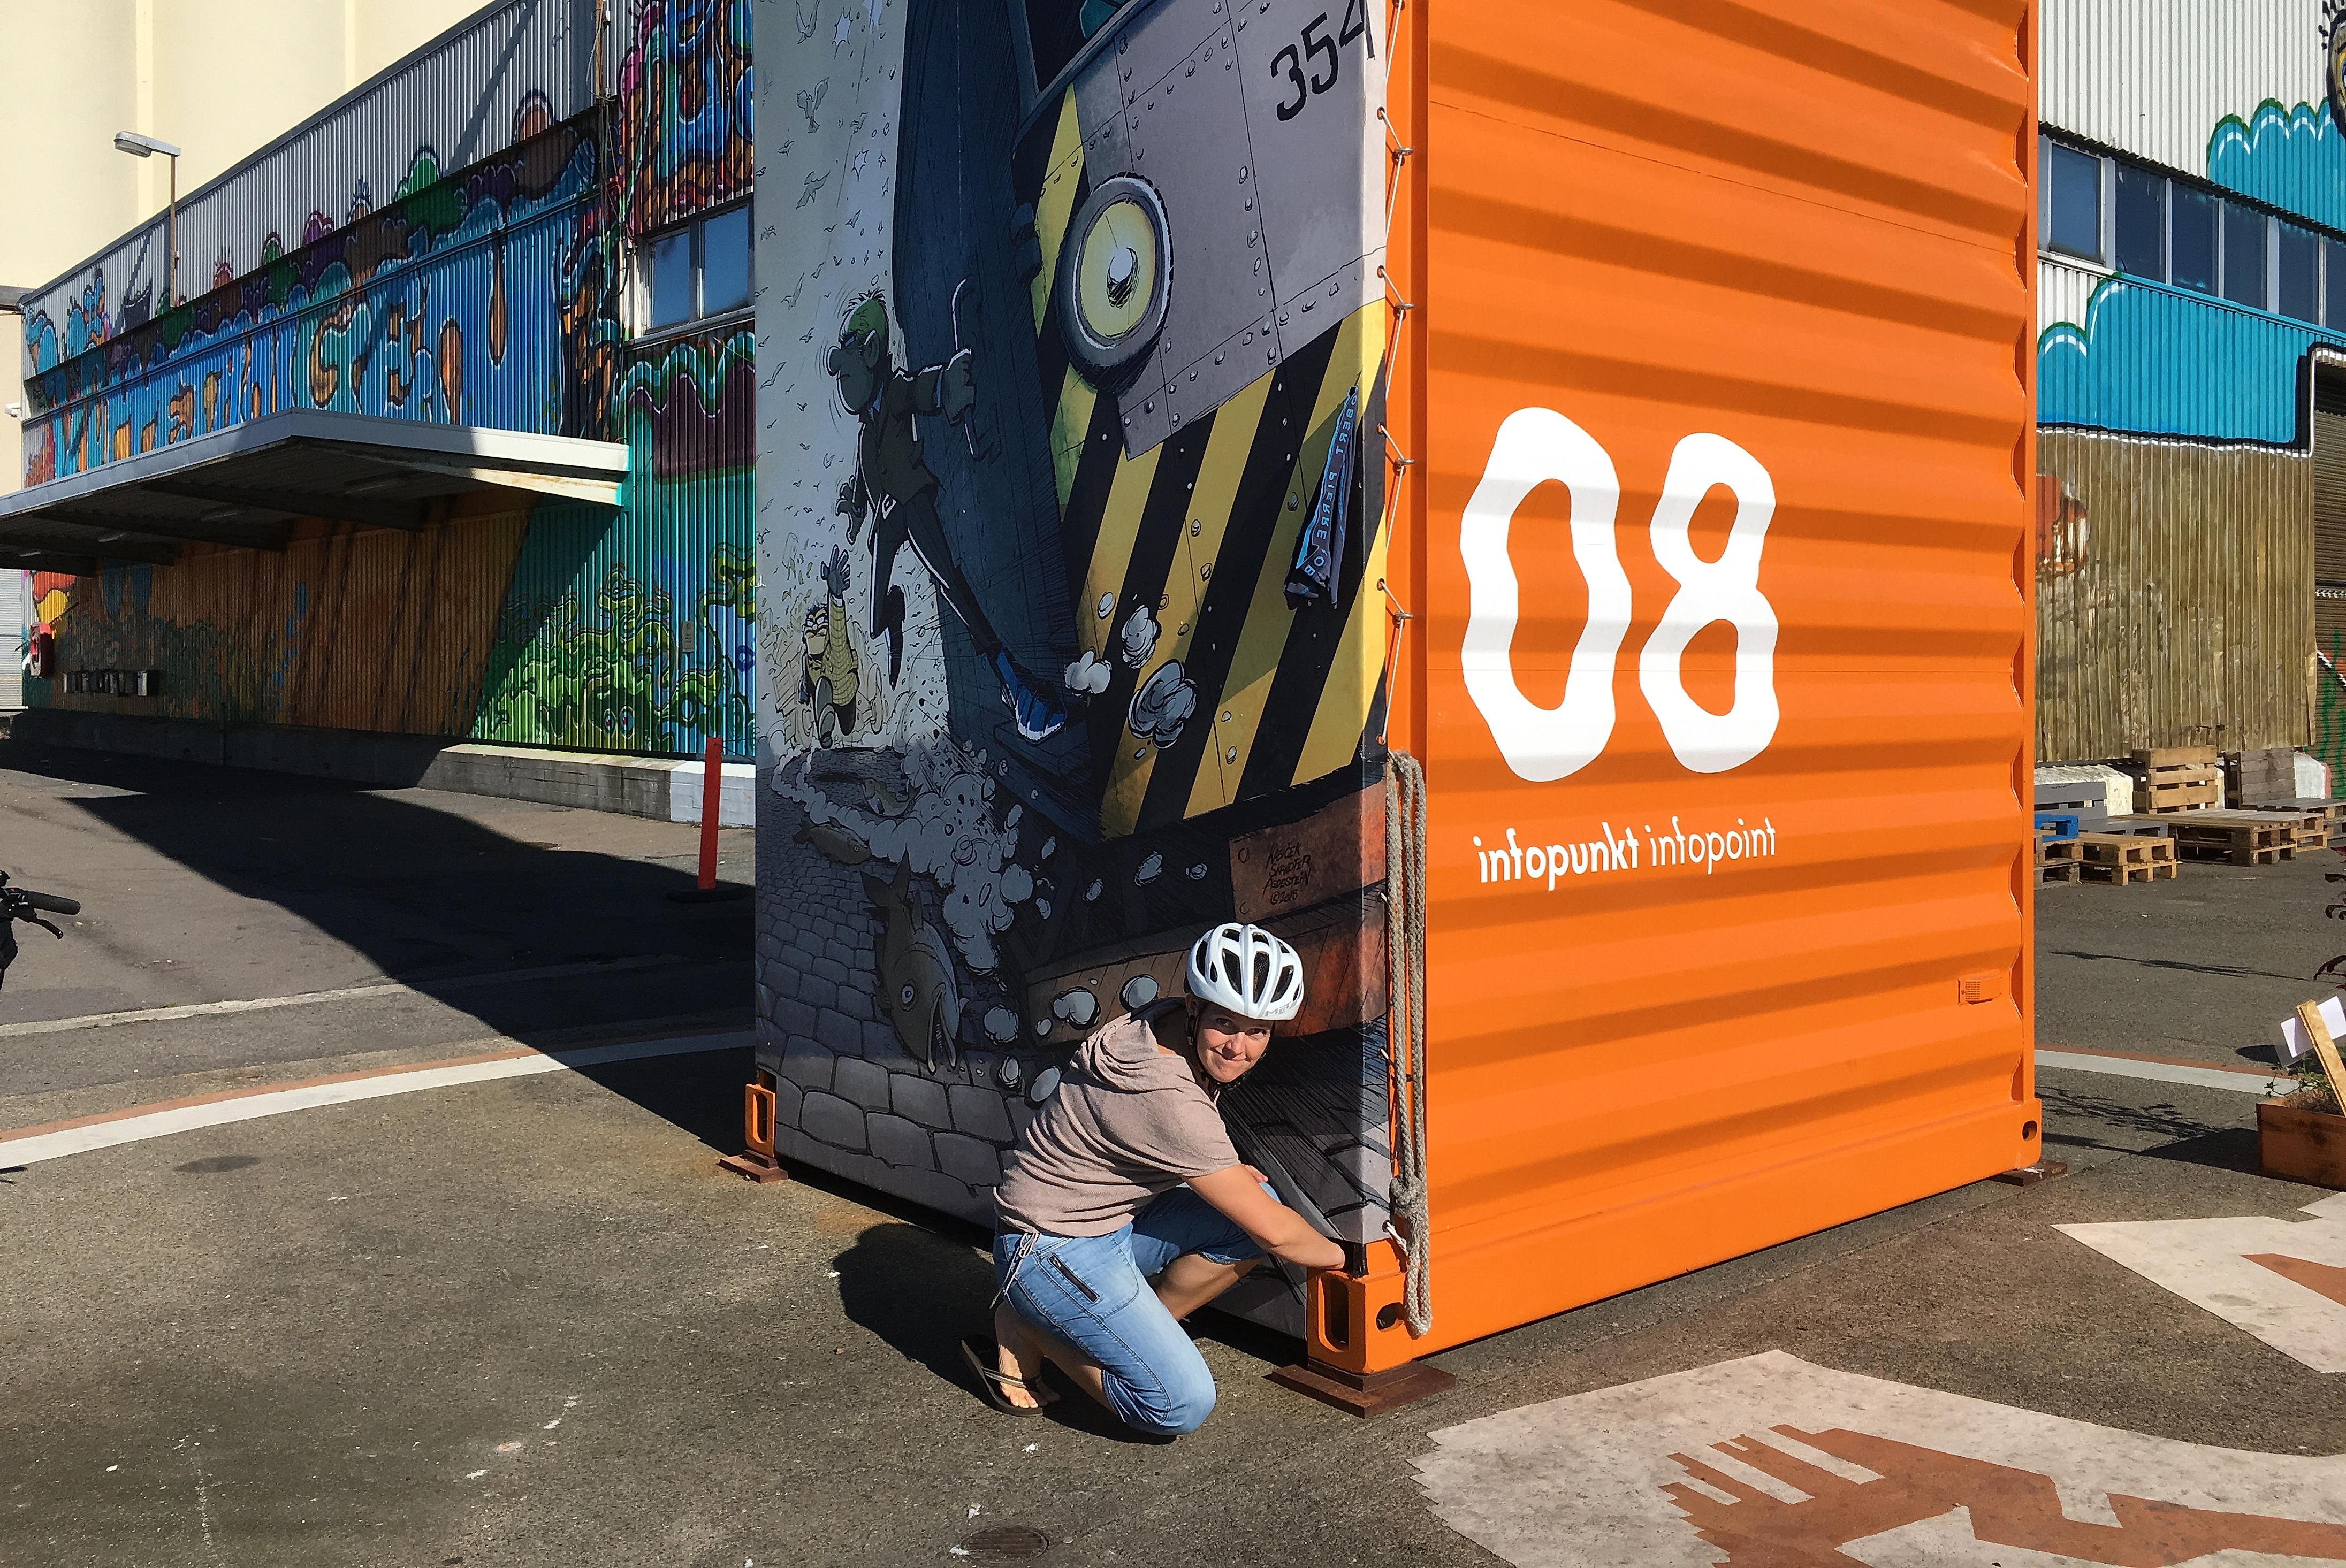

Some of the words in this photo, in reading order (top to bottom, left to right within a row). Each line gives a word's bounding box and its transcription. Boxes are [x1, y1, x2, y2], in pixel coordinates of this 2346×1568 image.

[1270, 0, 1376, 121] 354
[1460, 407, 1780, 782] 08
[1473, 822, 1639, 891] infopunkt
[1644, 816, 1776, 875] infopoint
